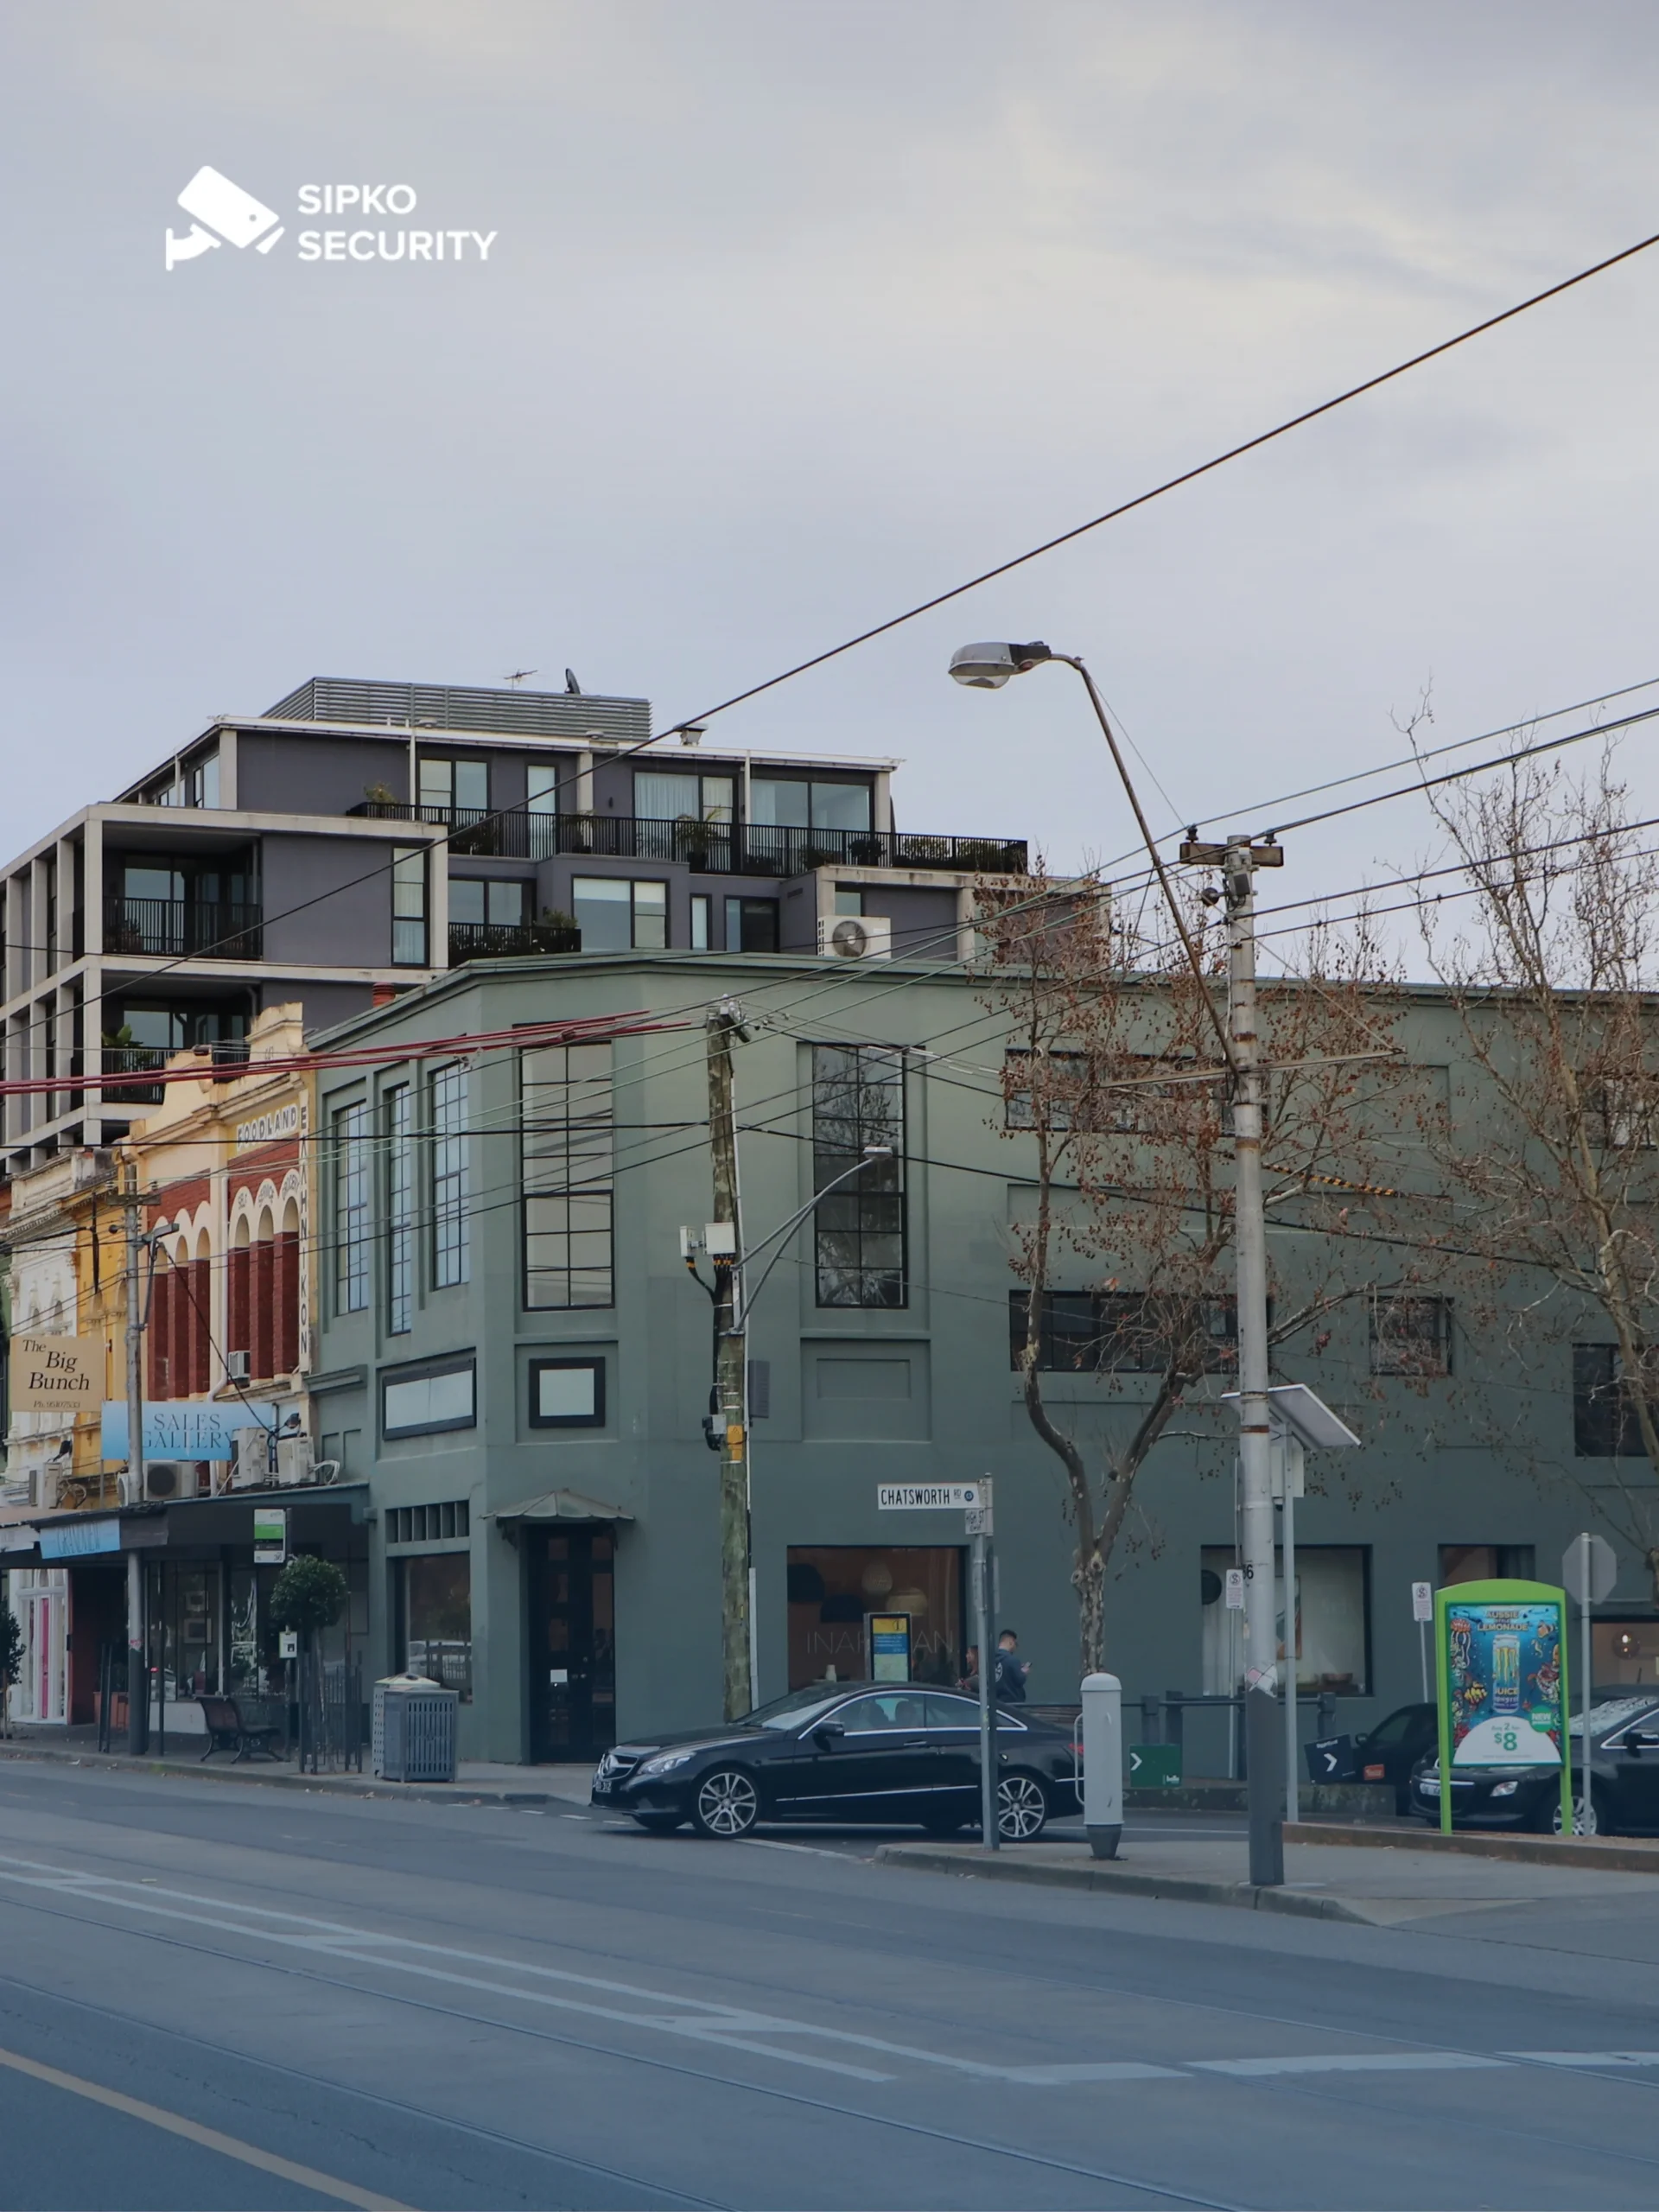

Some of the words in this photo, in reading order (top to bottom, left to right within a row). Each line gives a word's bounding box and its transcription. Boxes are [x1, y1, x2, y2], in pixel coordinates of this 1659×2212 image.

[237, 1106, 298, 1148] FOODLAND
[22, 1338, 47, 1352] The
[45, 1351, 78, 1373] Big
[28, 1371, 90, 1390] Bunch
[154, 1414, 221, 1431] SALES
[881, 1489, 950, 1505] CHATSWORTH
[1494, 1732, 1518, 1751] $8
